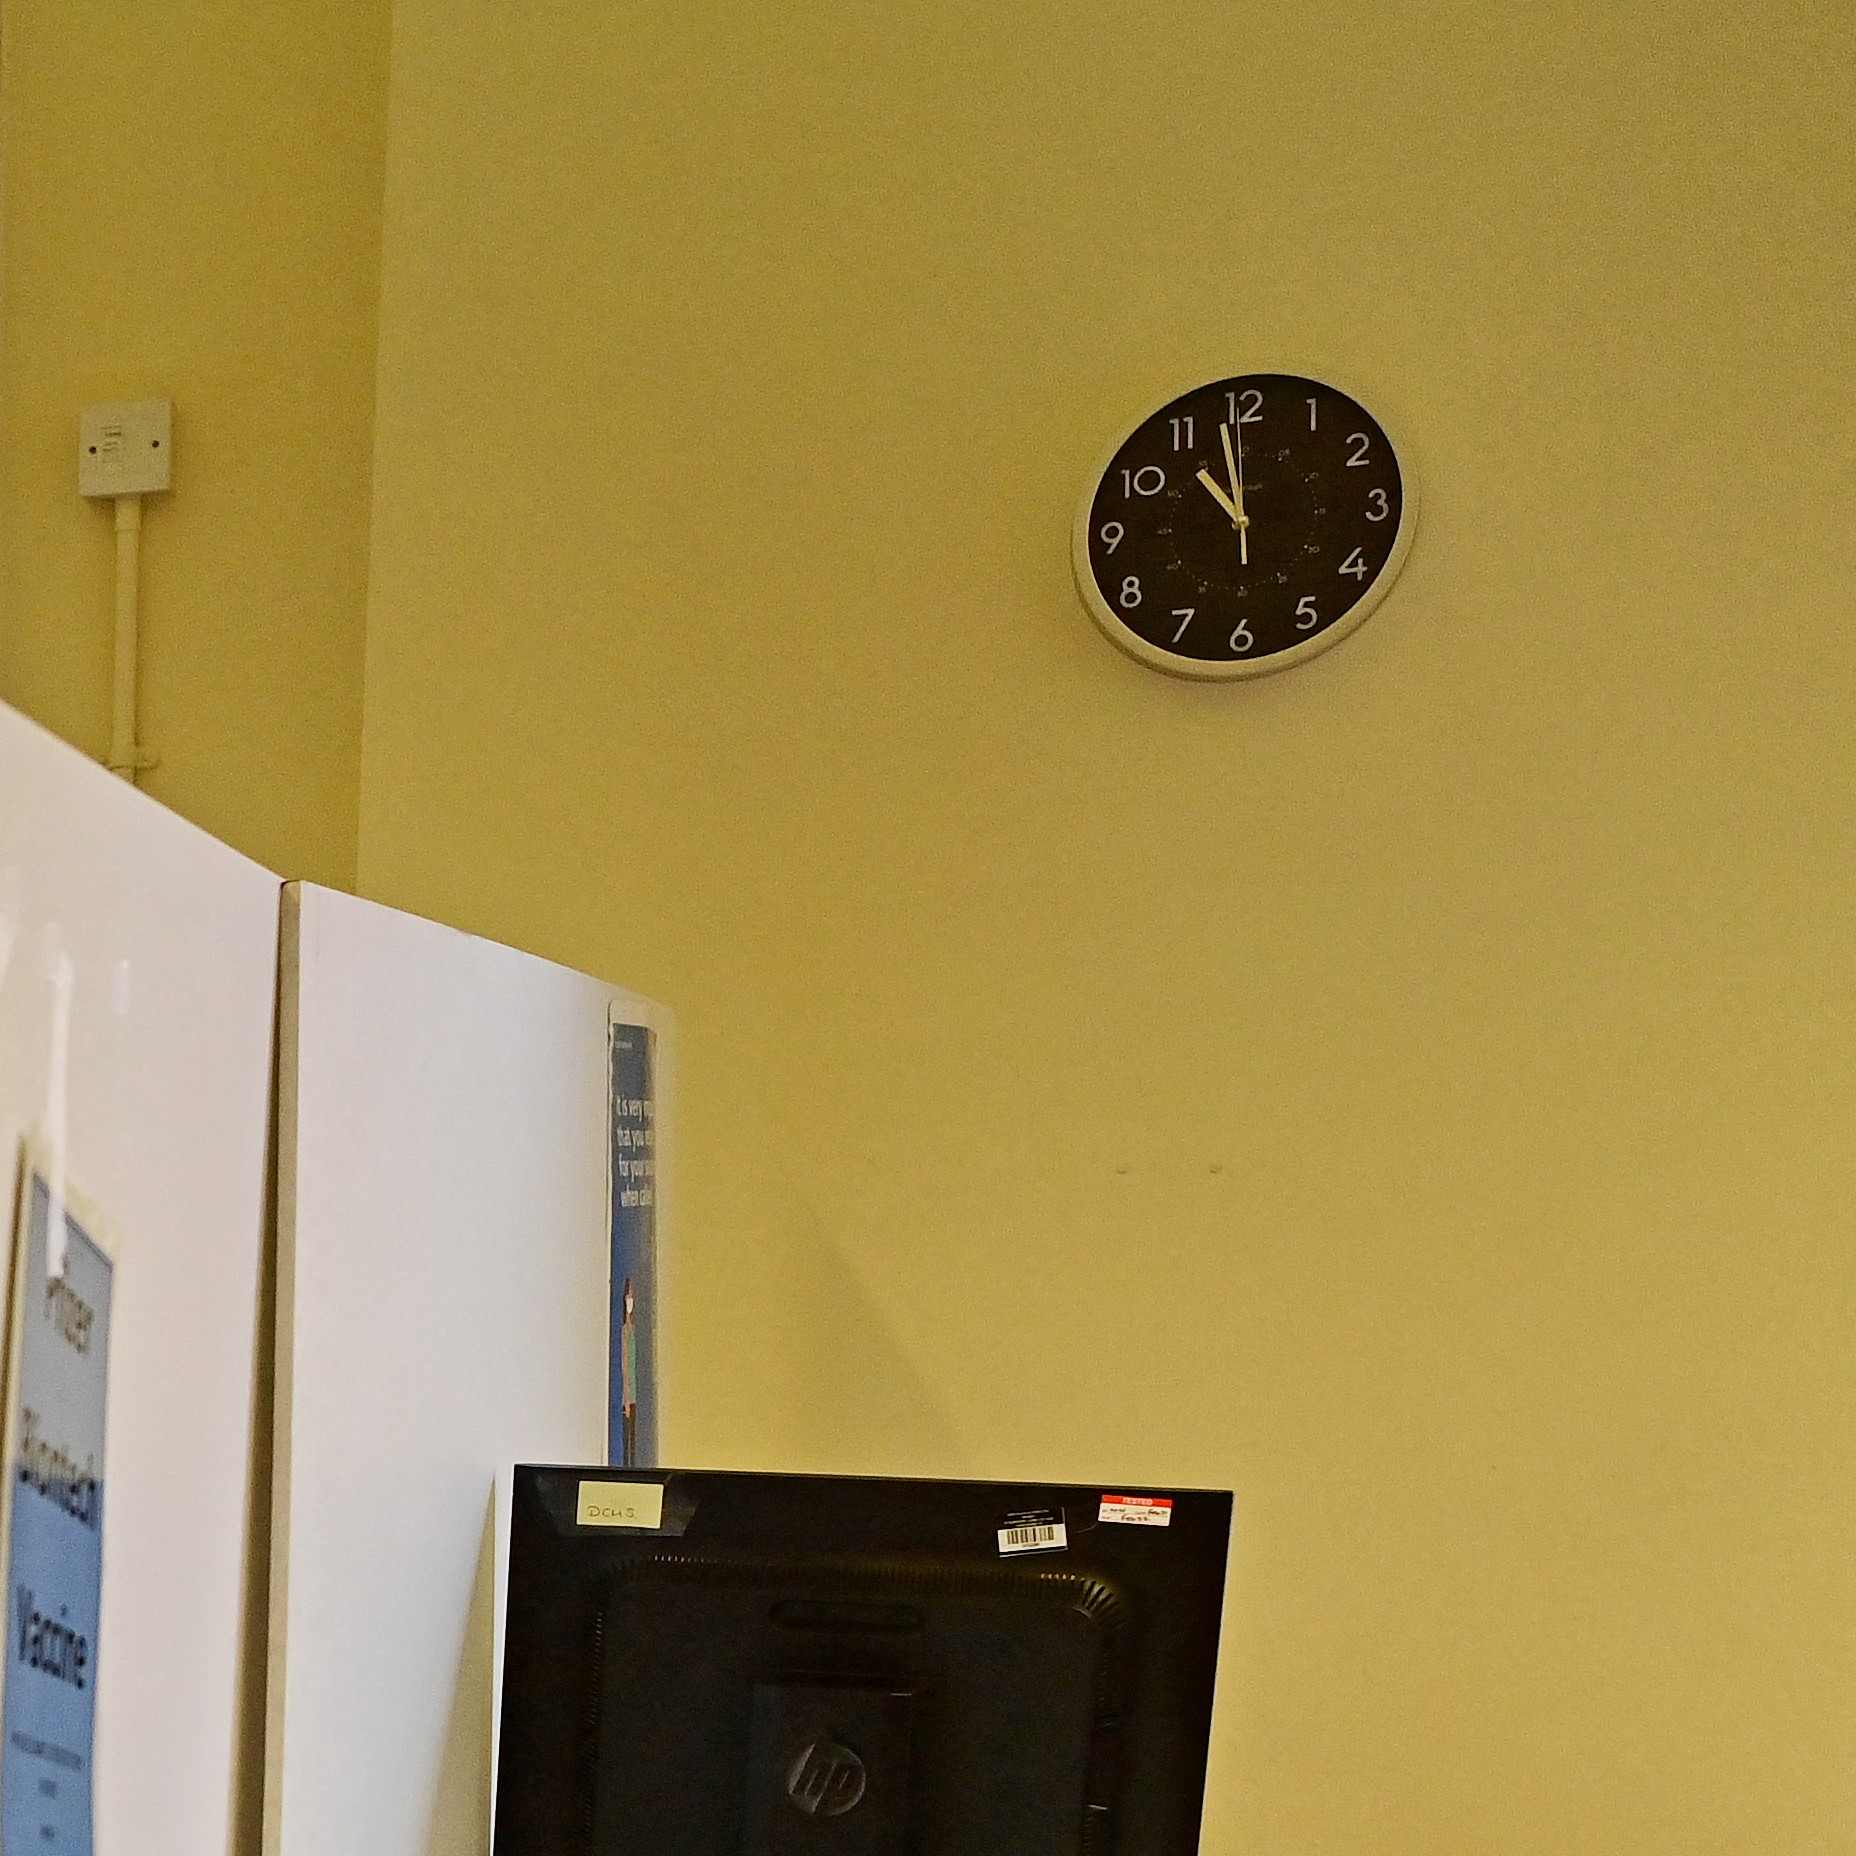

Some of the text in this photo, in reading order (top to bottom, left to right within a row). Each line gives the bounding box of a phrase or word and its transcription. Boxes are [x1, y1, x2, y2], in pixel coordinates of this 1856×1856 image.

[1225, 388, 1265, 425] 12
[1305, 397, 1318, 432] 1
[1169, 415, 1195, 451] 11
[1345, 432, 1371, 467] 2
[1121, 465, 1166, 499] 10
[1365, 488, 1391, 522] 3
[1100, 521, 1125, 555] 9
[1337, 546, 1369, 582] 4
[1119, 576, 1143, 609] 8
[1171, 609, 1196, 644] 7
[1295, 595, 1320, 630] 5
[1229, 618, 1255, 653] 6
[16, 1583, 91, 1691] Vaccine
